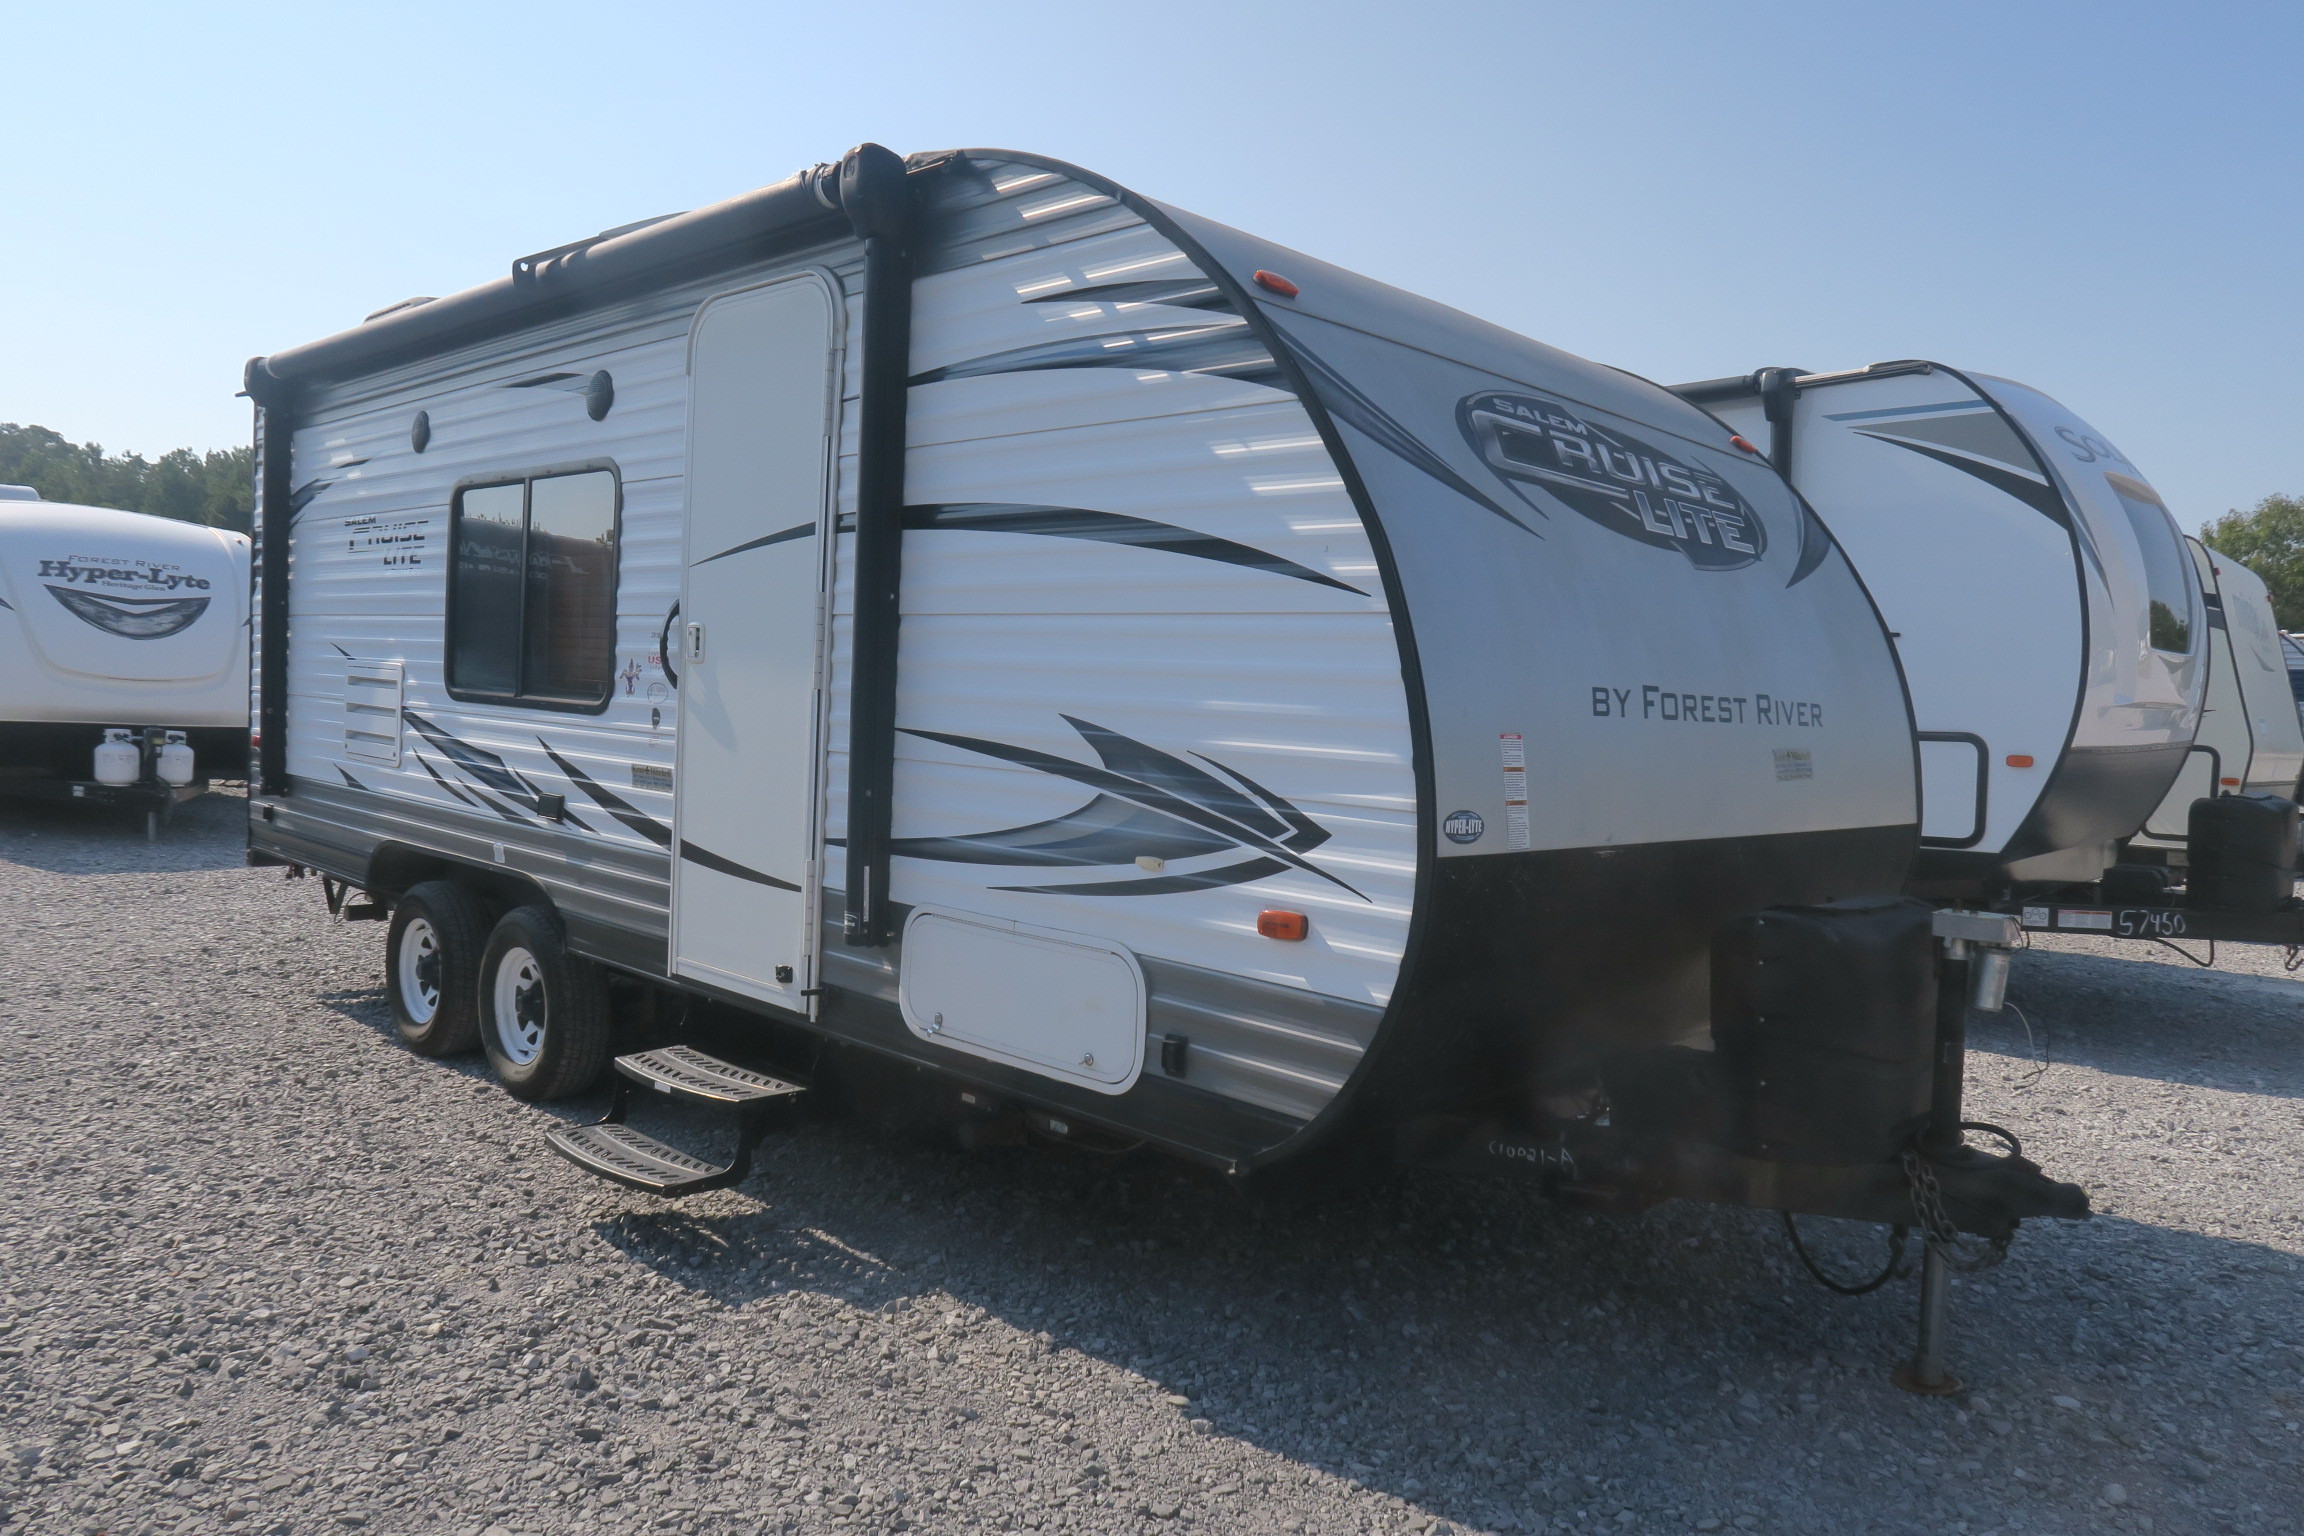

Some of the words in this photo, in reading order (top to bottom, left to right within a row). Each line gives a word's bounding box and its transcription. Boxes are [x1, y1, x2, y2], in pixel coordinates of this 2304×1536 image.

[1493, 398, 1588, 436] SALEM
[1472, 409, 1736, 510] CRUISE
[344, 517, 377, 527] SALEM
[1632, 489, 1756, 554] LITE
[37, 559, 211, 590] Hyper-Lyte
[68, 554, 130, 566] FOREST
[135, 559, 181, 571] RIVER
[1591, 686, 1631, 718] BY
[1445, 819, 1482, 835] HYPER-LYTE
[2118, 909, 2187, 936] 57450
